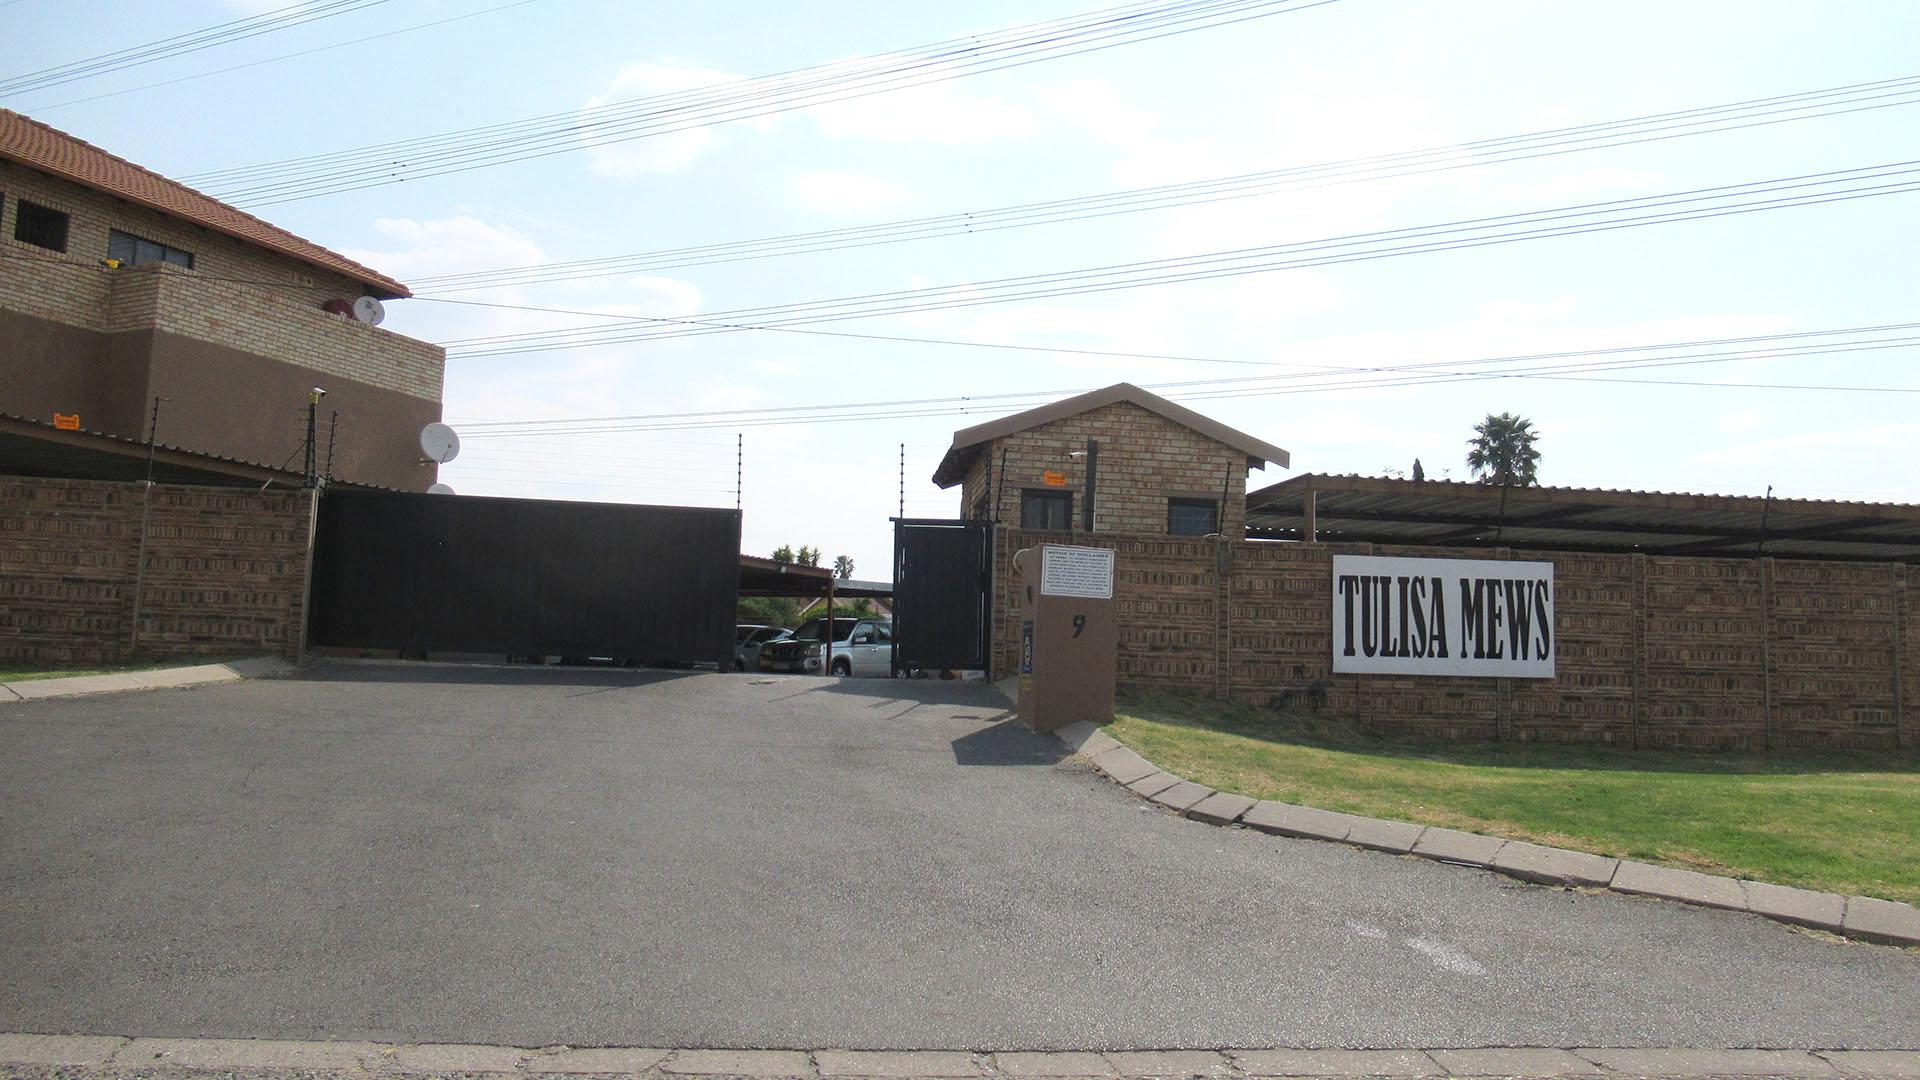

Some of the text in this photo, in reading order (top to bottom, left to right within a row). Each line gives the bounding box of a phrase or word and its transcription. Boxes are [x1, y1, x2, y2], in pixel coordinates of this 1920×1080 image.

[1072, 614, 1086, 639] 9
[1339, 575, 1550, 661] TULISA MEWS
